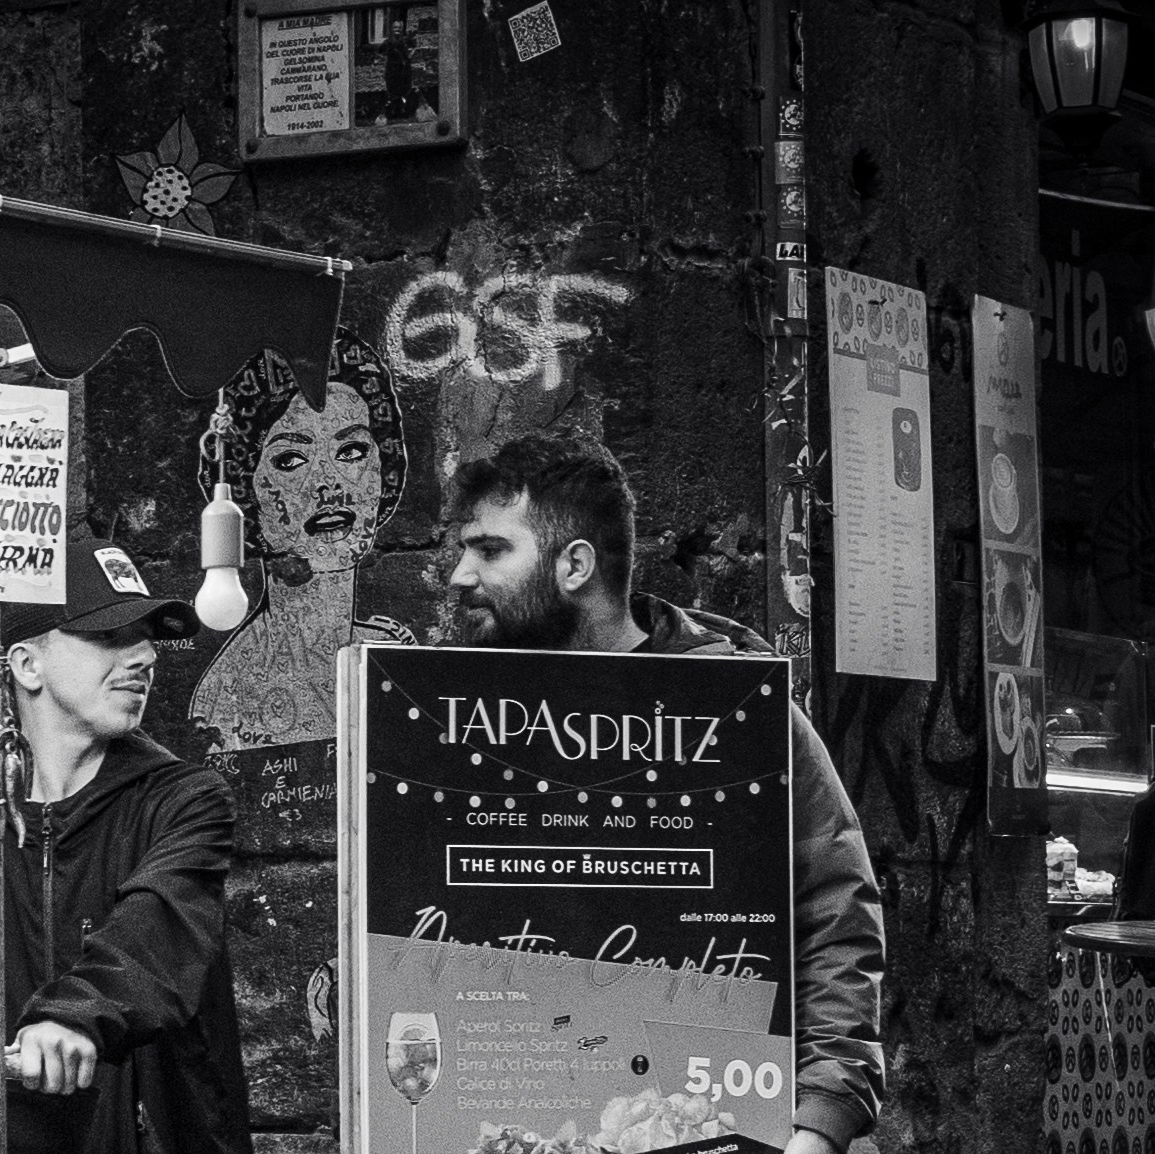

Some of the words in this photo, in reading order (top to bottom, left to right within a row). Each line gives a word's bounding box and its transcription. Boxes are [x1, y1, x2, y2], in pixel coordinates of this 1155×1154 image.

[303, 15, 333, 27] MADRE
[278, 38, 307, 48] QUESTO
[308, 34, 339, 45] ANGOLO
[266, 50, 280, 58] DEL
[281, 47, 306, 57] CUORE
[307, 46, 316, 55] DI
[316, 44, 344, 53] NAPOLI
[270, 74, 313, 86] TRASCORSE
[314, 73, 324, 82] LA
[297, 84, 312, 92] VITA
[285, 92, 325, 103] PORTANDO
[270, 104, 297, 113] NAPOLI
[298, 102, 312, 111] NEL
[287, 120, 324, 131] 1914-2002
[438, 697, 722, 763] TAPASPRITZ
[261, 757, 298, 777] ASHI
[274, 775, 287, 789] E
[466, 812, 528, 827] COFFEE
[541, 813, 590, 828] DRINK
[602, 814, 637, 828] AND
[649, 815, 694, 830] FOOD
[460, 858, 495, 873] THE
[501, 859, 546, 874] KING
[551, 860, 577, 874] OF
[582, 859, 702, 876] BRUSCHETTA
[680, 913, 703, 922] dalle
[704, 913, 729, 922] 17:00
[730, 913, 747, 923] alle
[748, 913, 776, 923] 22:00
[590, 924, 771, 1001] Completo
[456, 991, 464, 1001] A
[466, 991, 503, 1001] SCELTA
[684, 1055, 784, 1102] 5,00
